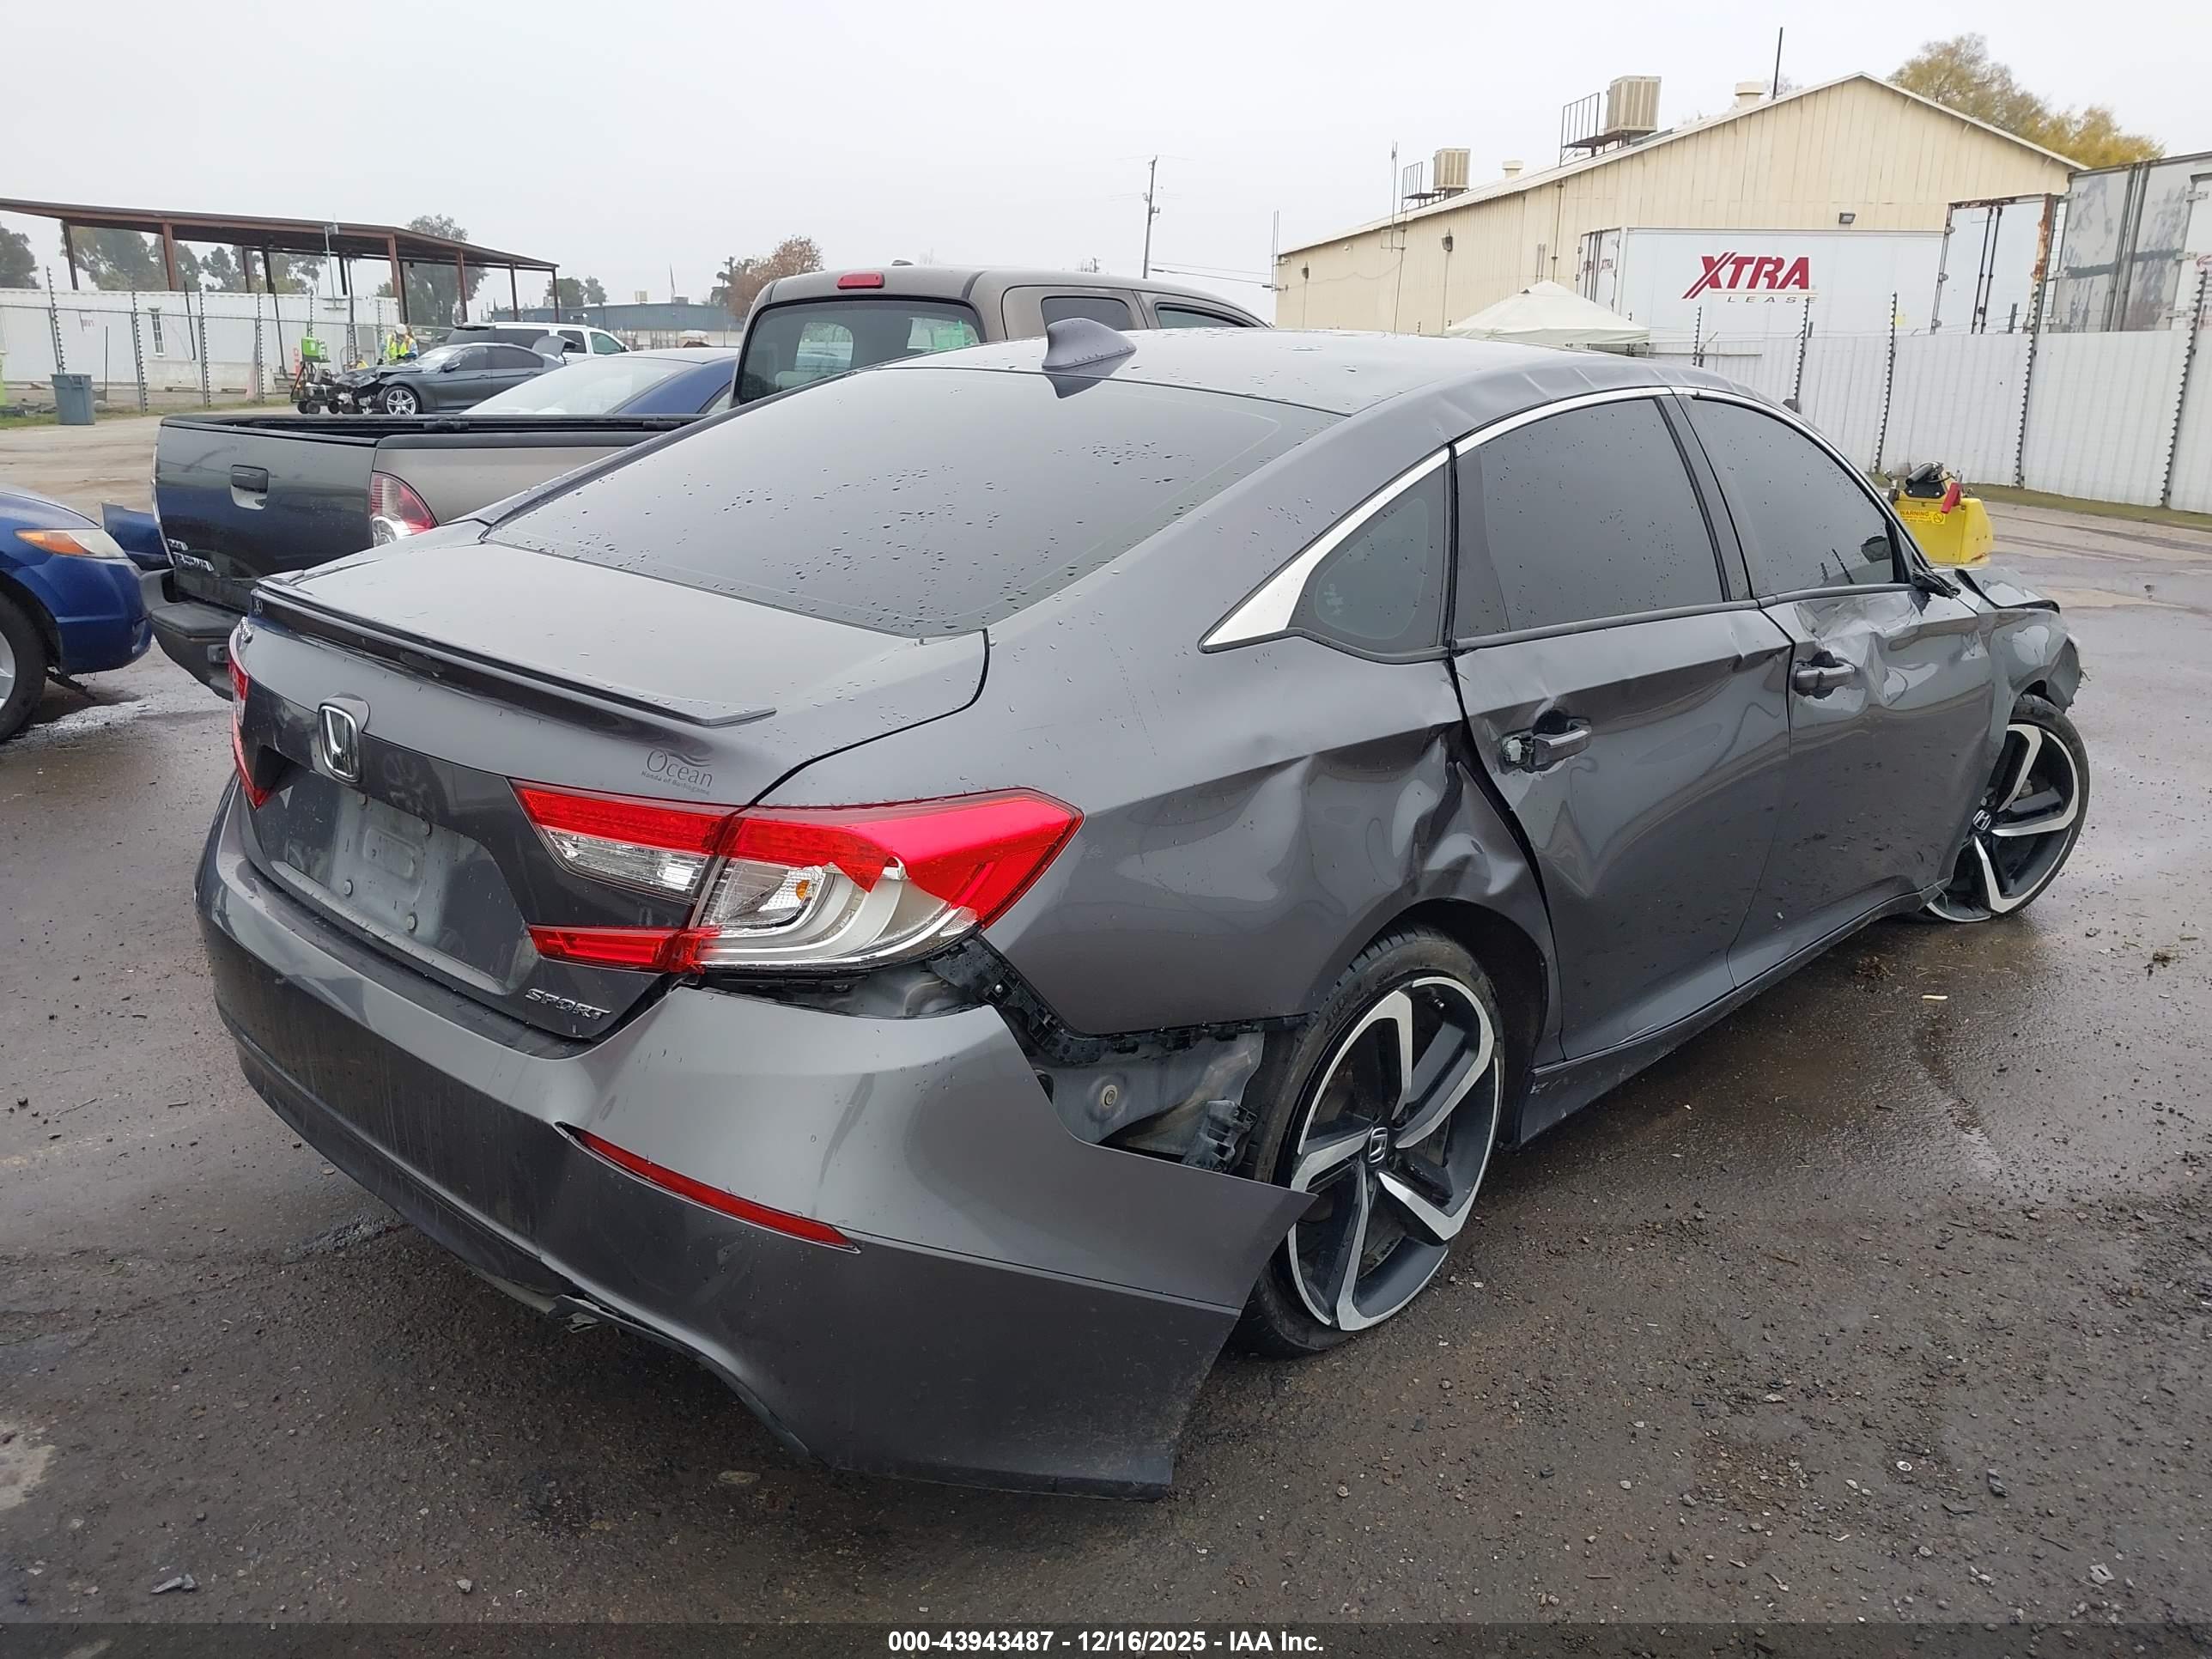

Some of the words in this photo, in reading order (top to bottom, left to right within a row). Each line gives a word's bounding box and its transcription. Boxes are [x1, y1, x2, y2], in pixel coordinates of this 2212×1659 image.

[1681, 252, 1809, 299] XTRA
[647, 750, 713, 787] Ocean
[525, 988, 611, 1020] SPORT
